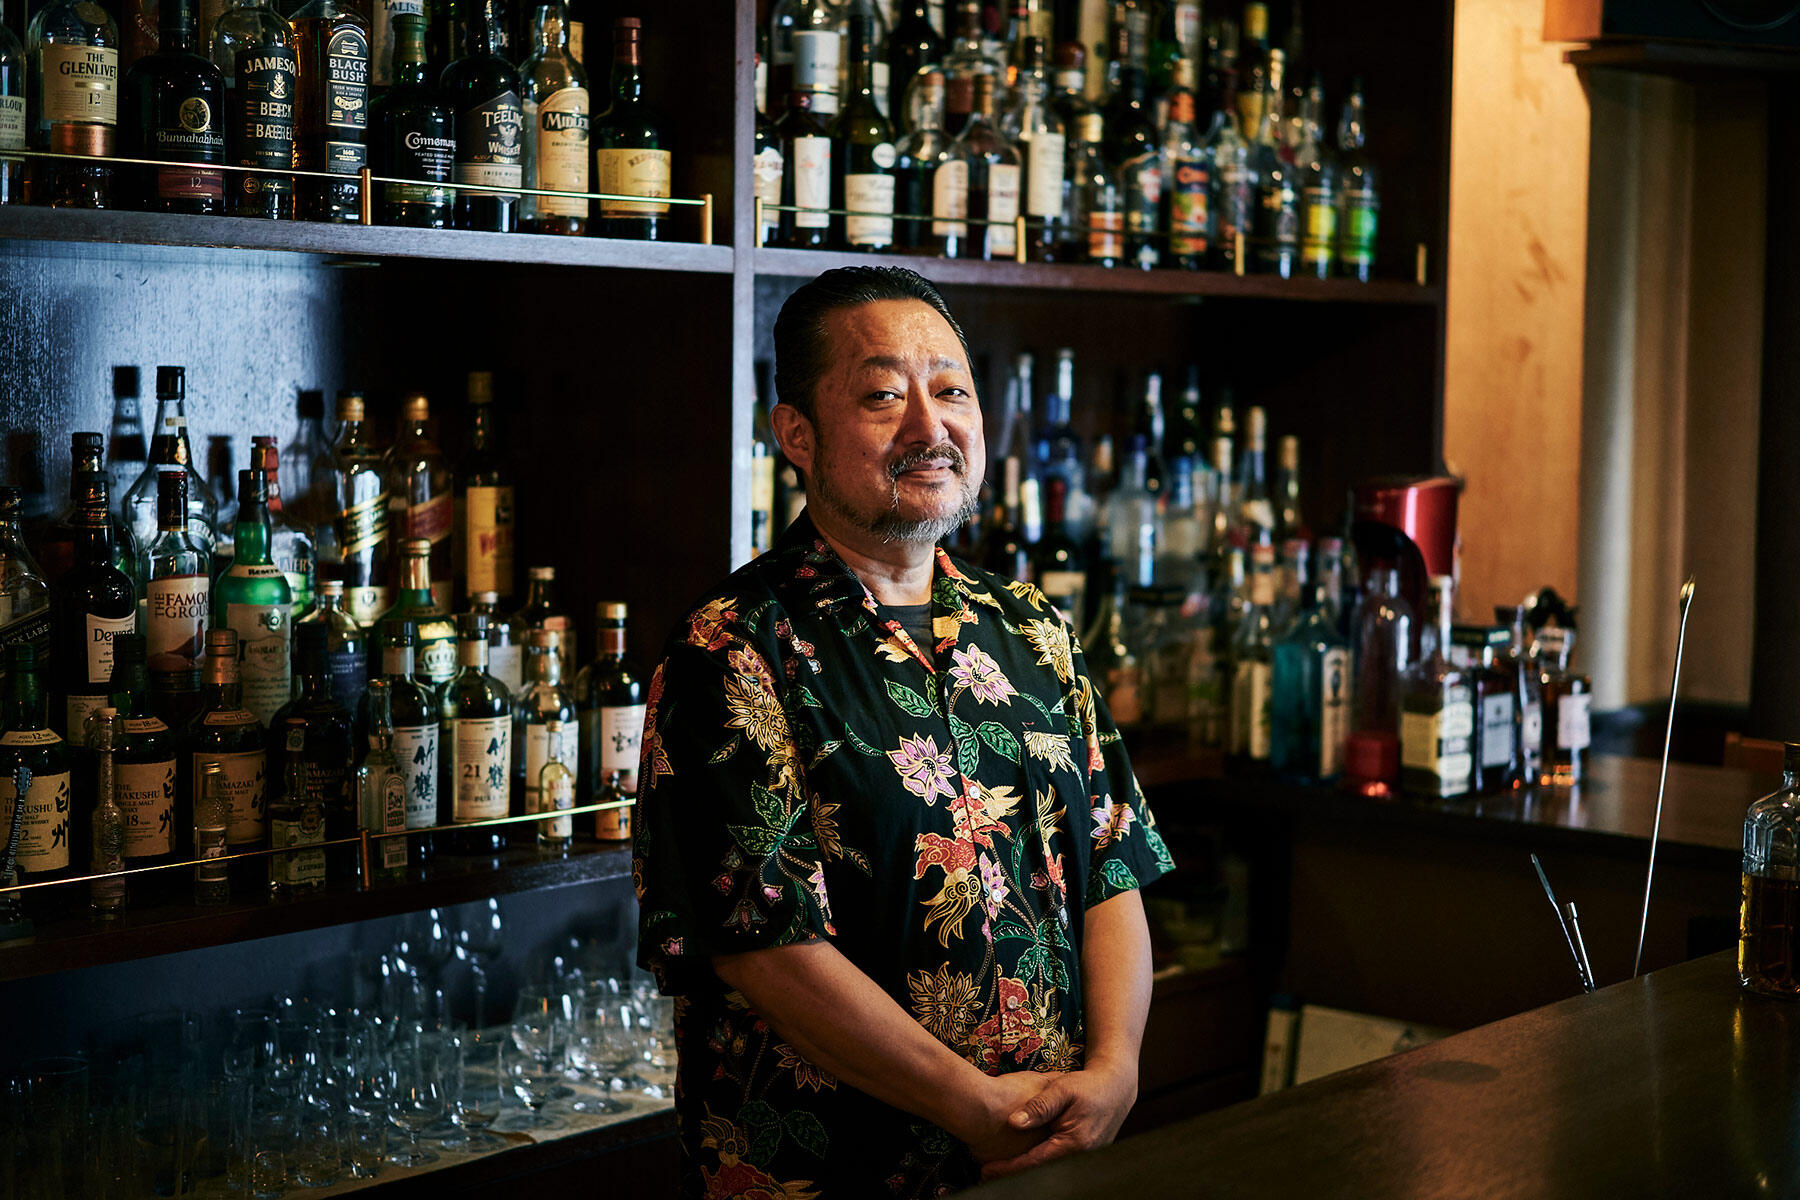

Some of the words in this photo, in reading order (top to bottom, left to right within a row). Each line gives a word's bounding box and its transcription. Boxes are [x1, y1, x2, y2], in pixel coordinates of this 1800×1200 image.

[86, 52, 104, 63] THE
[244, 56, 296, 76] JAMESO
[331, 58, 367, 72] BLACK
[332, 69, 364, 82] BUSH
[88, 93, 101, 104] 12
[157, 131, 224, 146] Bunnahabhain
[191, 177, 202, 188] 12
[32, 731, 41, 740] 12
[463, 764, 480, 778] 21
[219, 780, 254, 790] AMAZAKI
[5, 802, 53, 814] HKUSHU
[52, 781, 70, 849] 白州
[127, 815, 138, 826] 18
